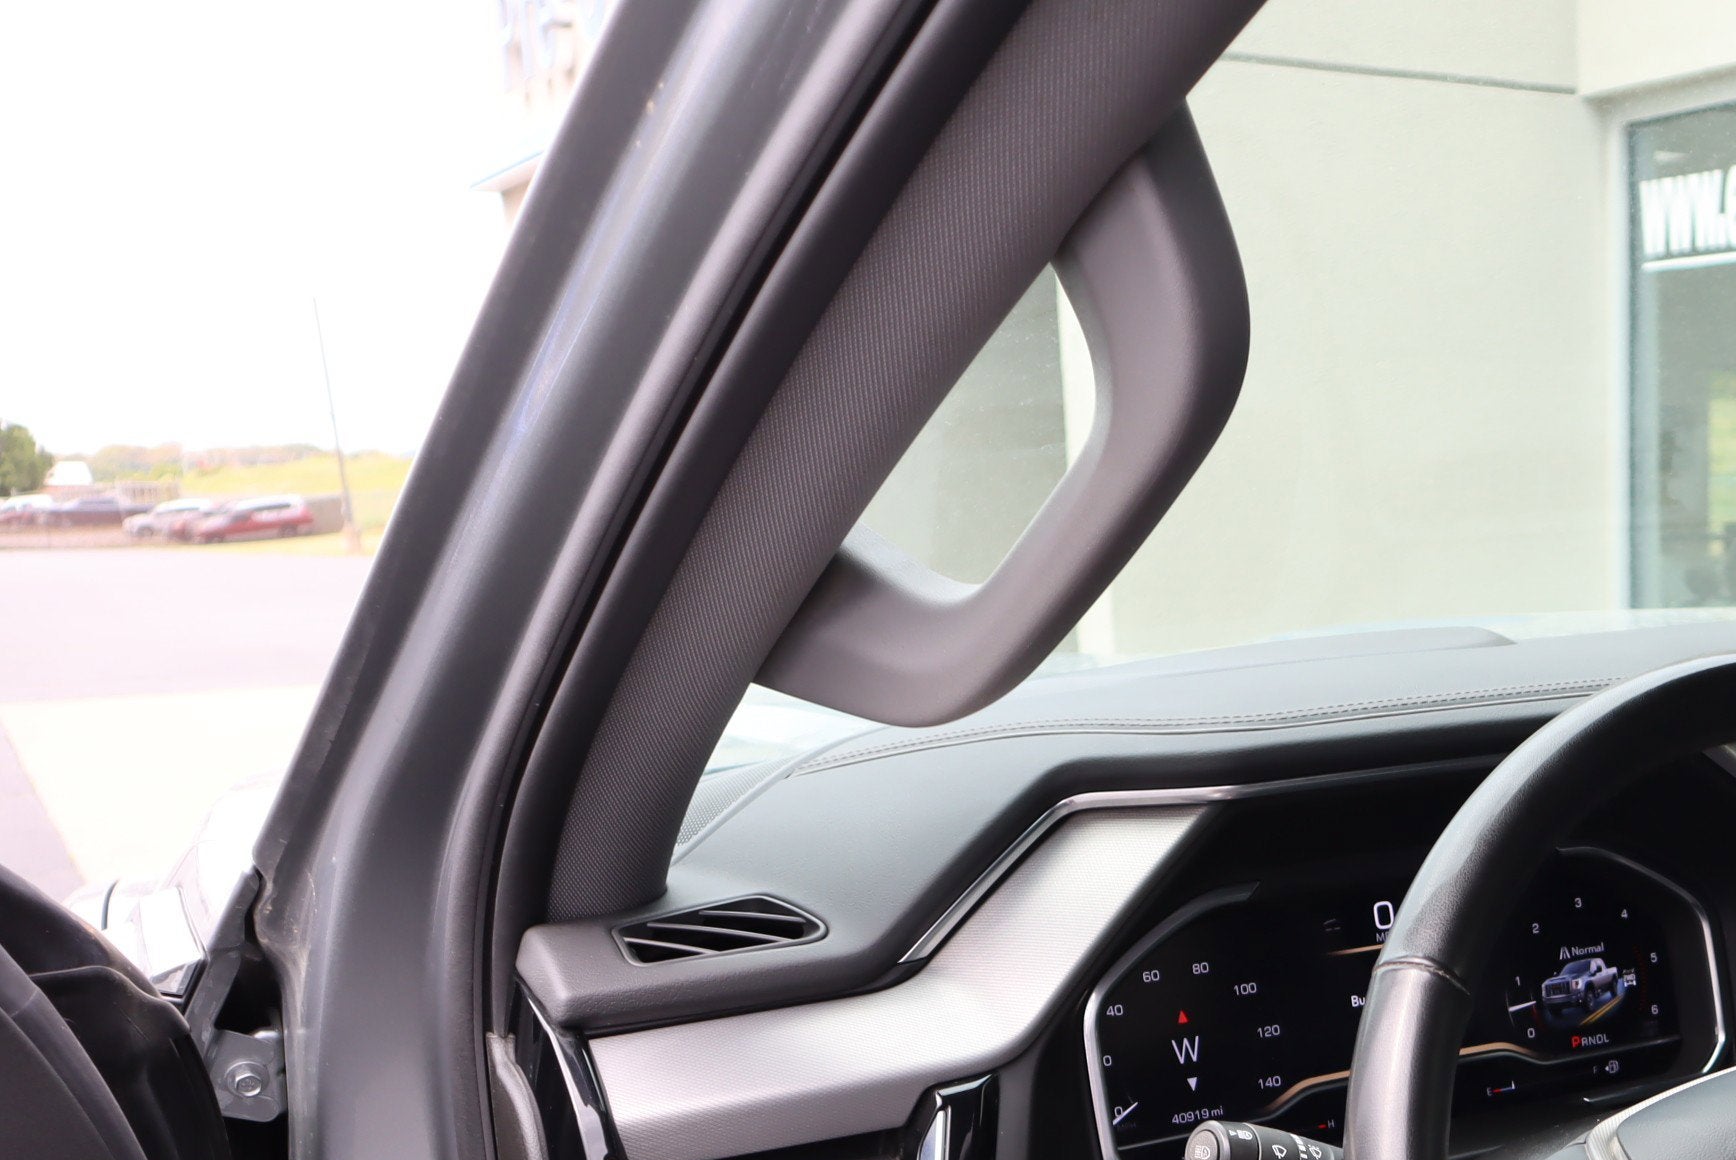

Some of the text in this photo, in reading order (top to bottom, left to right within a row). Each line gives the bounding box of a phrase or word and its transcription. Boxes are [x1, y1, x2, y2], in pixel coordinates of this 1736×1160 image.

[1574, 898, 1582, 908] 3
[1620, 908, 1629, 919] 4
[1532, 923, 1540, 934] 2
[1571, 942, 1605, 957] Normal
[1650, 952, 1658, 963] 5
[1192, 962, 1210, 975] 80
[1142, 970, 1160, 983] 60
[1515, 976, 1521, 986] 1
[1234, 982, 1257, 996] 100
[1106, 1004, 1124, 1017] 40
[1651, 1004, 1659, 1015] 6
[1256, 1024, 1280, 1038] 120
[1527, 1028, 1536, 1038] 0
[1171, 1035, 1200, 1065] W
[1257, 1076, 1281, 1090] 140
[1171, 1105, 1223, 1125] 40919 mi
